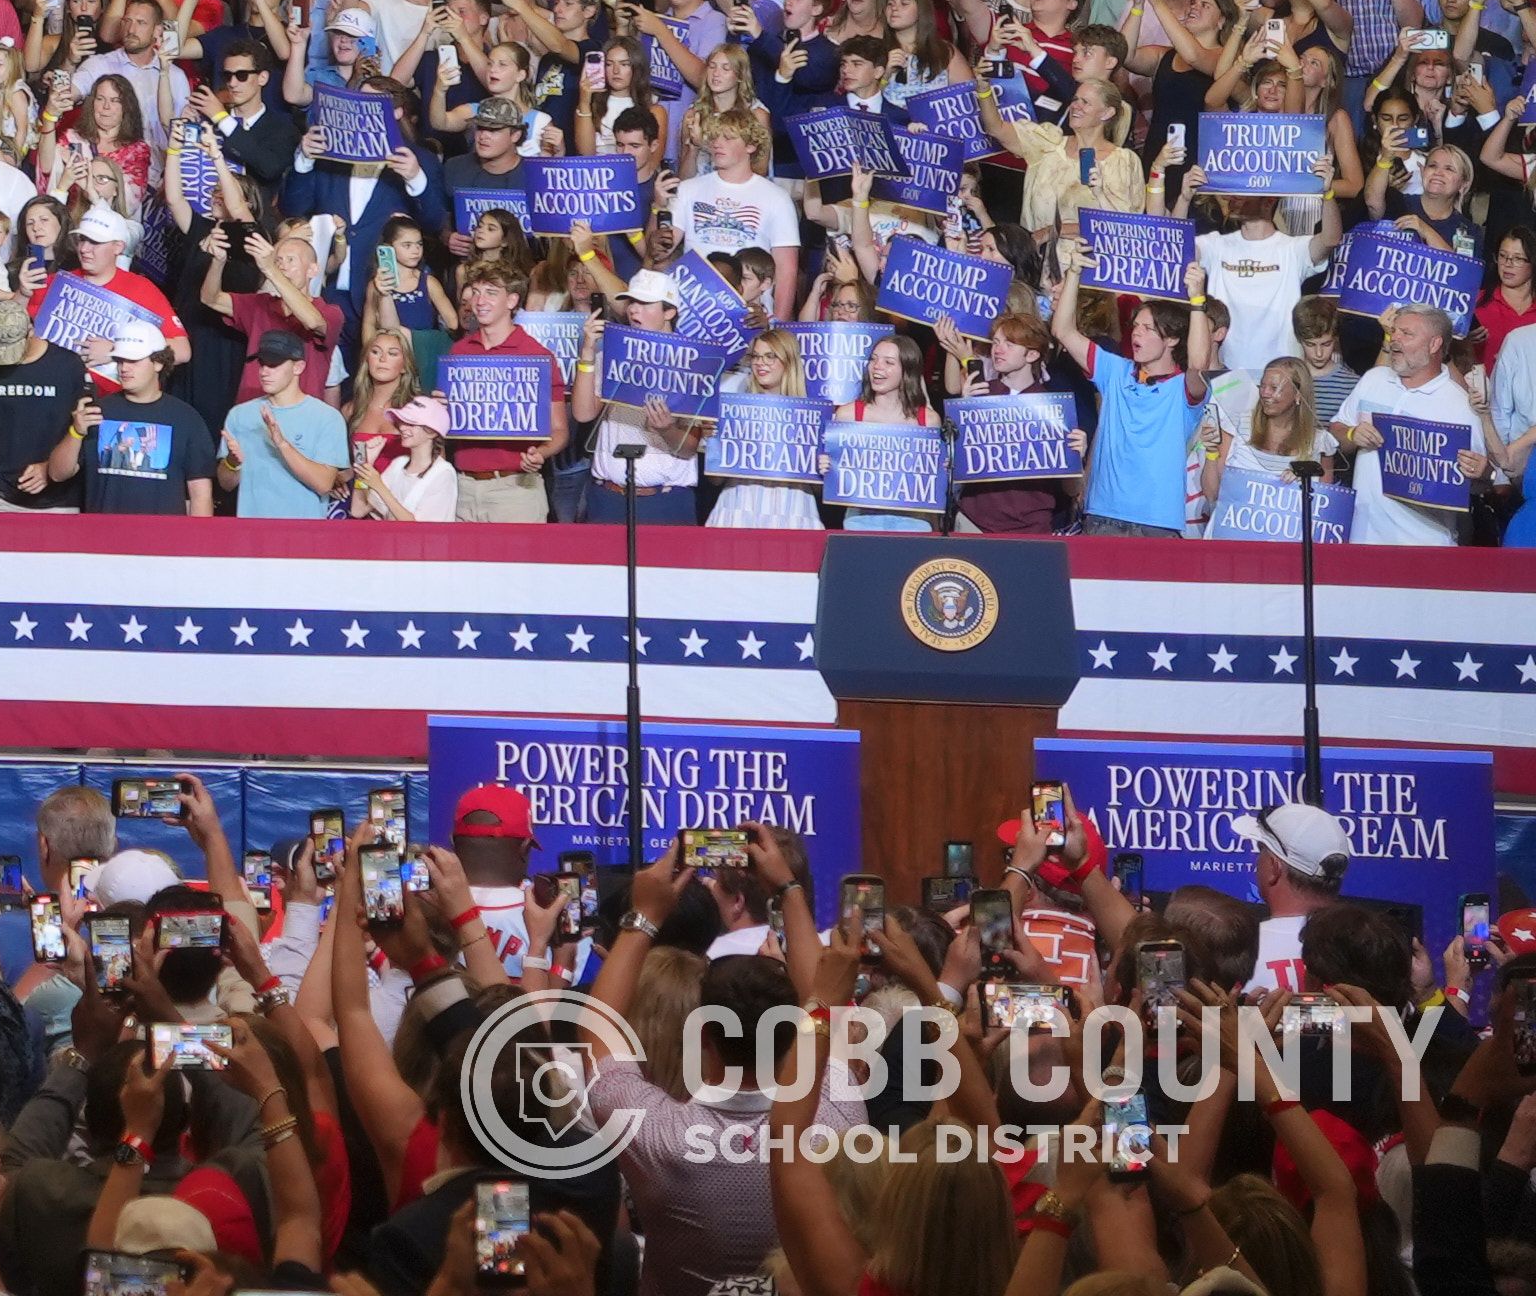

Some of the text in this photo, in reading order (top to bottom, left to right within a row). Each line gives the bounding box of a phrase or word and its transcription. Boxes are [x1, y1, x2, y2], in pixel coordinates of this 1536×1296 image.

[318, 92, 383, 114] POWERING THE
[929, 83, 1005, 123] TRUP
[319, 106, 386, 133] AMERICAN
[799, 115, 858, 137] POWERING
[1222, 124, 1301, 147] TRUMP
[320, 124, 394, 158] DREAM
[808, 130, 890, 153] AMERICAN
[894, 135, 949, 166] TRUMP
[181, 144, 200, 203] TRUM
[811, 145, 901, 174] DREAM
[1204, 149, 1319, 174] ACCOUNTS
[542, 168, 615, 191] TRUMP
[1245, 175, 1273, 189] .GOV
[464, 198, 527, 215] POWERING
[534, 189, 637, 216] ACCOUNTS
[1089, 218, 1184, 244] POWERING THE
[1093, 234, 1184, 264] AMERICAN
[1376, 245, 1459, 284] TRUMP
[912, 249, 987, 291] TRUMP
[1093, 253, 1182, 293] DREAM
[59, 284, 118, 317] POWERING
[886, 269, 999, 320] ACCOUNTS
[1349, 267, 1471, 316] ACCOUNTS
[51, 298, 117, 339] AMERIC
[675, 264, 749, 354] ACCOUNTS
[623, 336, 699, 370] TRUMP
[796, 333, 873, 357] TRUMP
[447, 367, 540, 382] POWERING THE
[607, 359, 716, 396] ACCOUNTS
[448, 381, 539, 403] AMERICAN
[450, 402, 539, 432] DREAM
[721, 403, 822, 425] POWERING THE
[959, 404, 1065, 425] POWERING THE
[720, 419, 821, 445] AMERICAN
[839, 432, 941, 454] POWERING THE
[962, 420, 1065, 445] AMERICAN
[1392, 424, 1448, 457] TRUMP
[719, 439, 819, 475] DREAM
[838, 448, 939, 474] AMERICAN
[964, 441, 1068, 475] DREAM
[1383, 450, 1465, 486] ACCOUNTS
[837, 468, 938, 504] DREAM
[1246, 480, 1330, 518] TRUP
[1220, 504, 1345, 544] ACCOUTS
[496, 741, 789, 813] POWERNG THE
[1332, 771, 1418, 816] THE
[677, 790, 817, 837] DREAM
[1347, 815, 1450, 861] REAM
